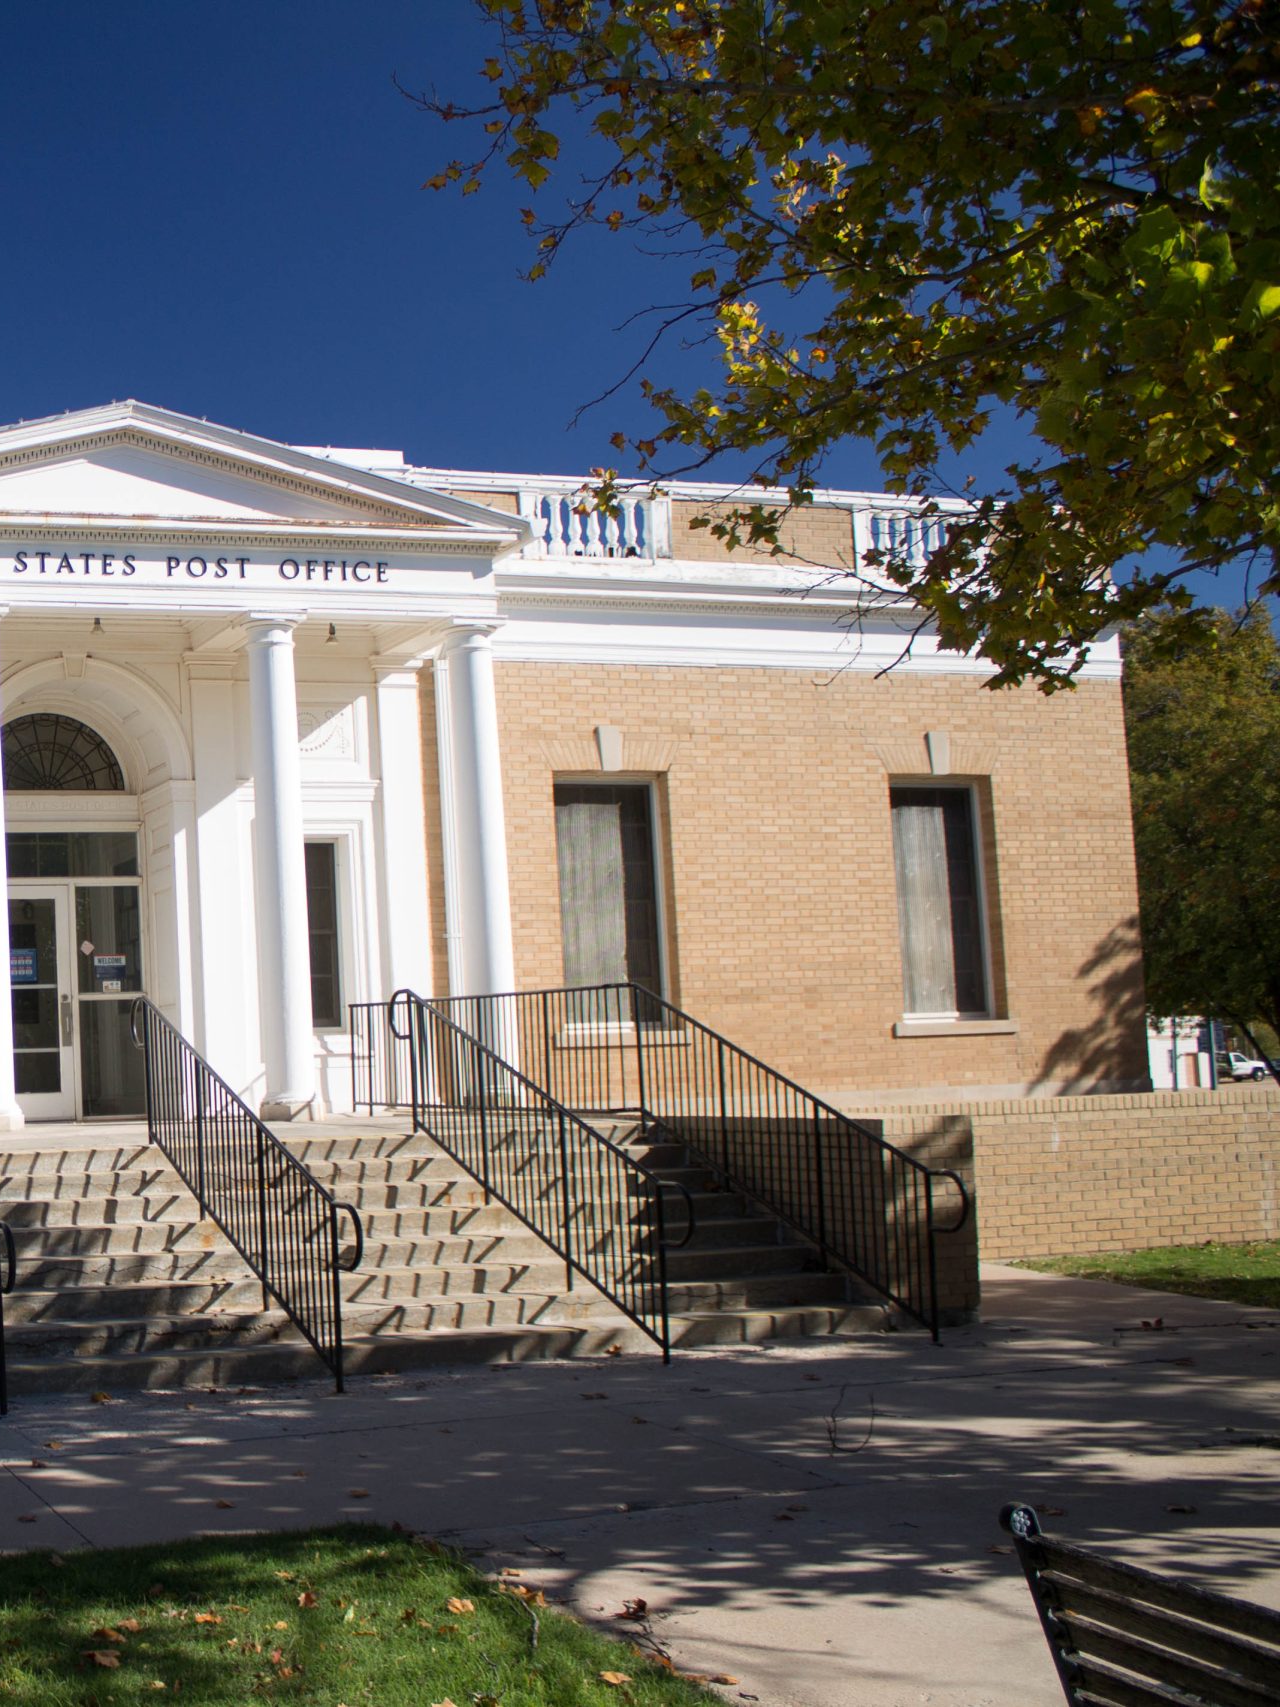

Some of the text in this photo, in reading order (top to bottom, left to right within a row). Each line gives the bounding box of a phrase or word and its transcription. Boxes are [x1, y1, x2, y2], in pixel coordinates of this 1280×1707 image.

[13, 551, 136, 576] STATES
[166, 556, 250, 579] POST
[279, 559, 389, 583] OFFICE
